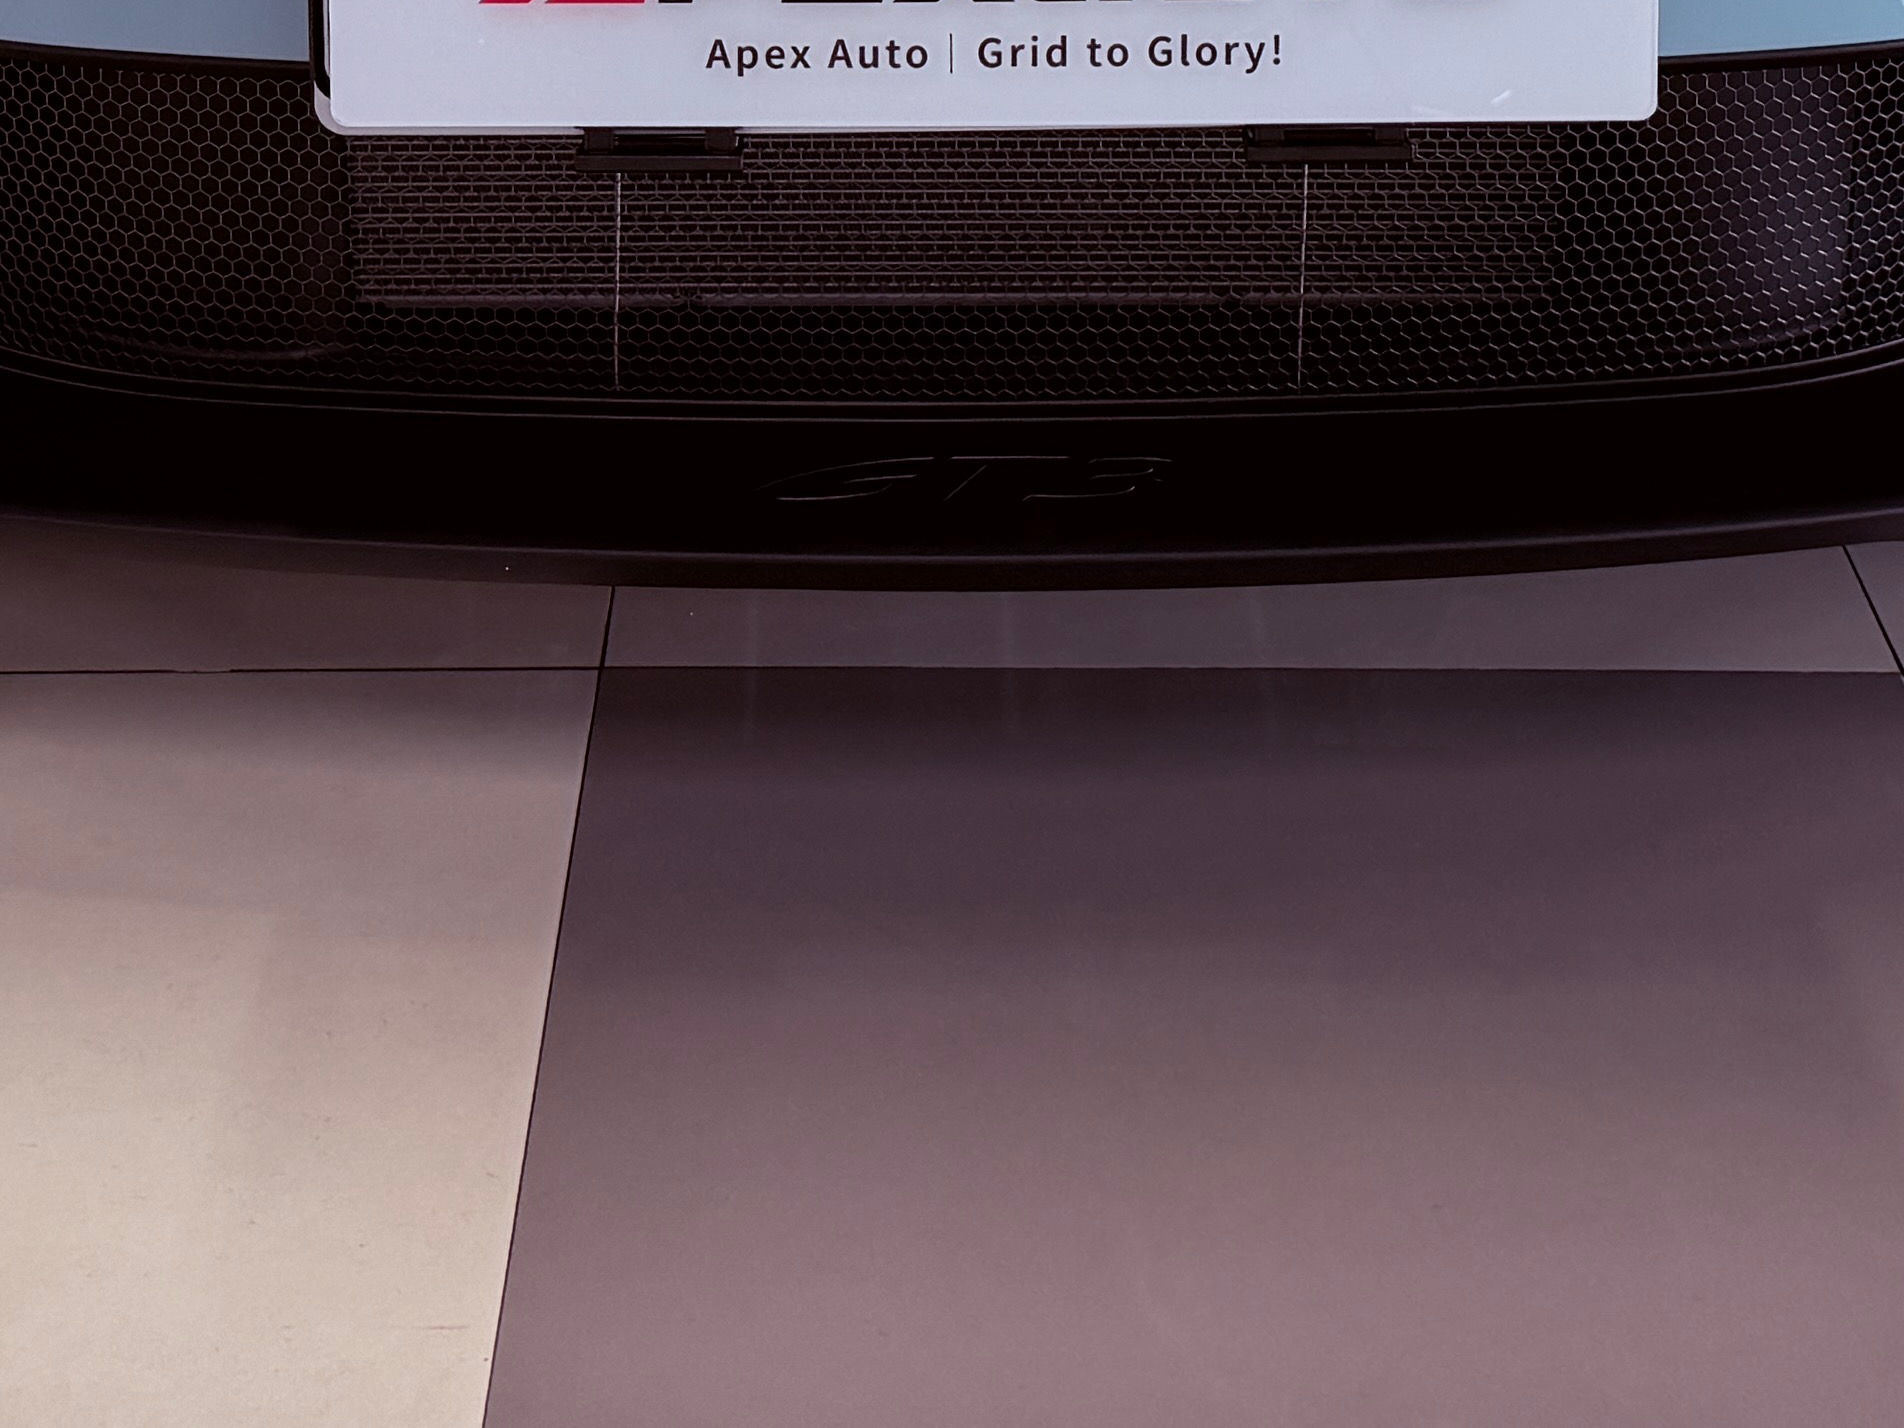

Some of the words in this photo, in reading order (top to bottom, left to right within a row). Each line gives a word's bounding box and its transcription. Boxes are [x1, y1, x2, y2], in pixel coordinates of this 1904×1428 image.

[705, 38, 812, 78] Apex
[827, 38, 928, 70] Auto
[977, 34, 1068, 69] Grid
[1086, 37, 1129, 68] to
[1147, 33, 1281, 75] Glory!
